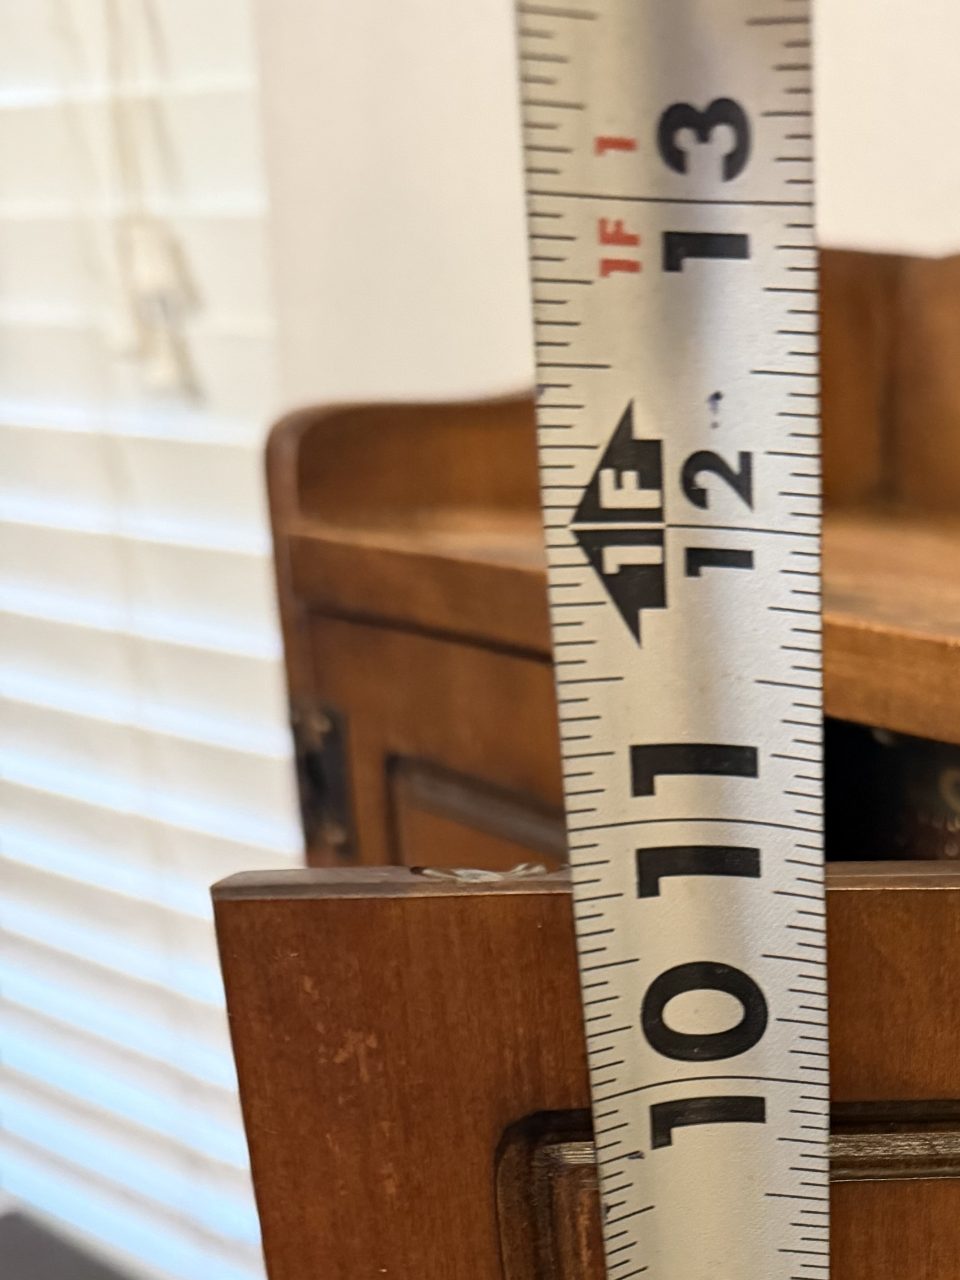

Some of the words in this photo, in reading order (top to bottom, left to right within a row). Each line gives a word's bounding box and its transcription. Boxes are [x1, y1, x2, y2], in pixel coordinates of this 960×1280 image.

[656, 97, 752, 273] 13
[679, 450, 755, 578] 12
[629, 743, 761, 899] 11
[640, 960, 769, 1151] 10
